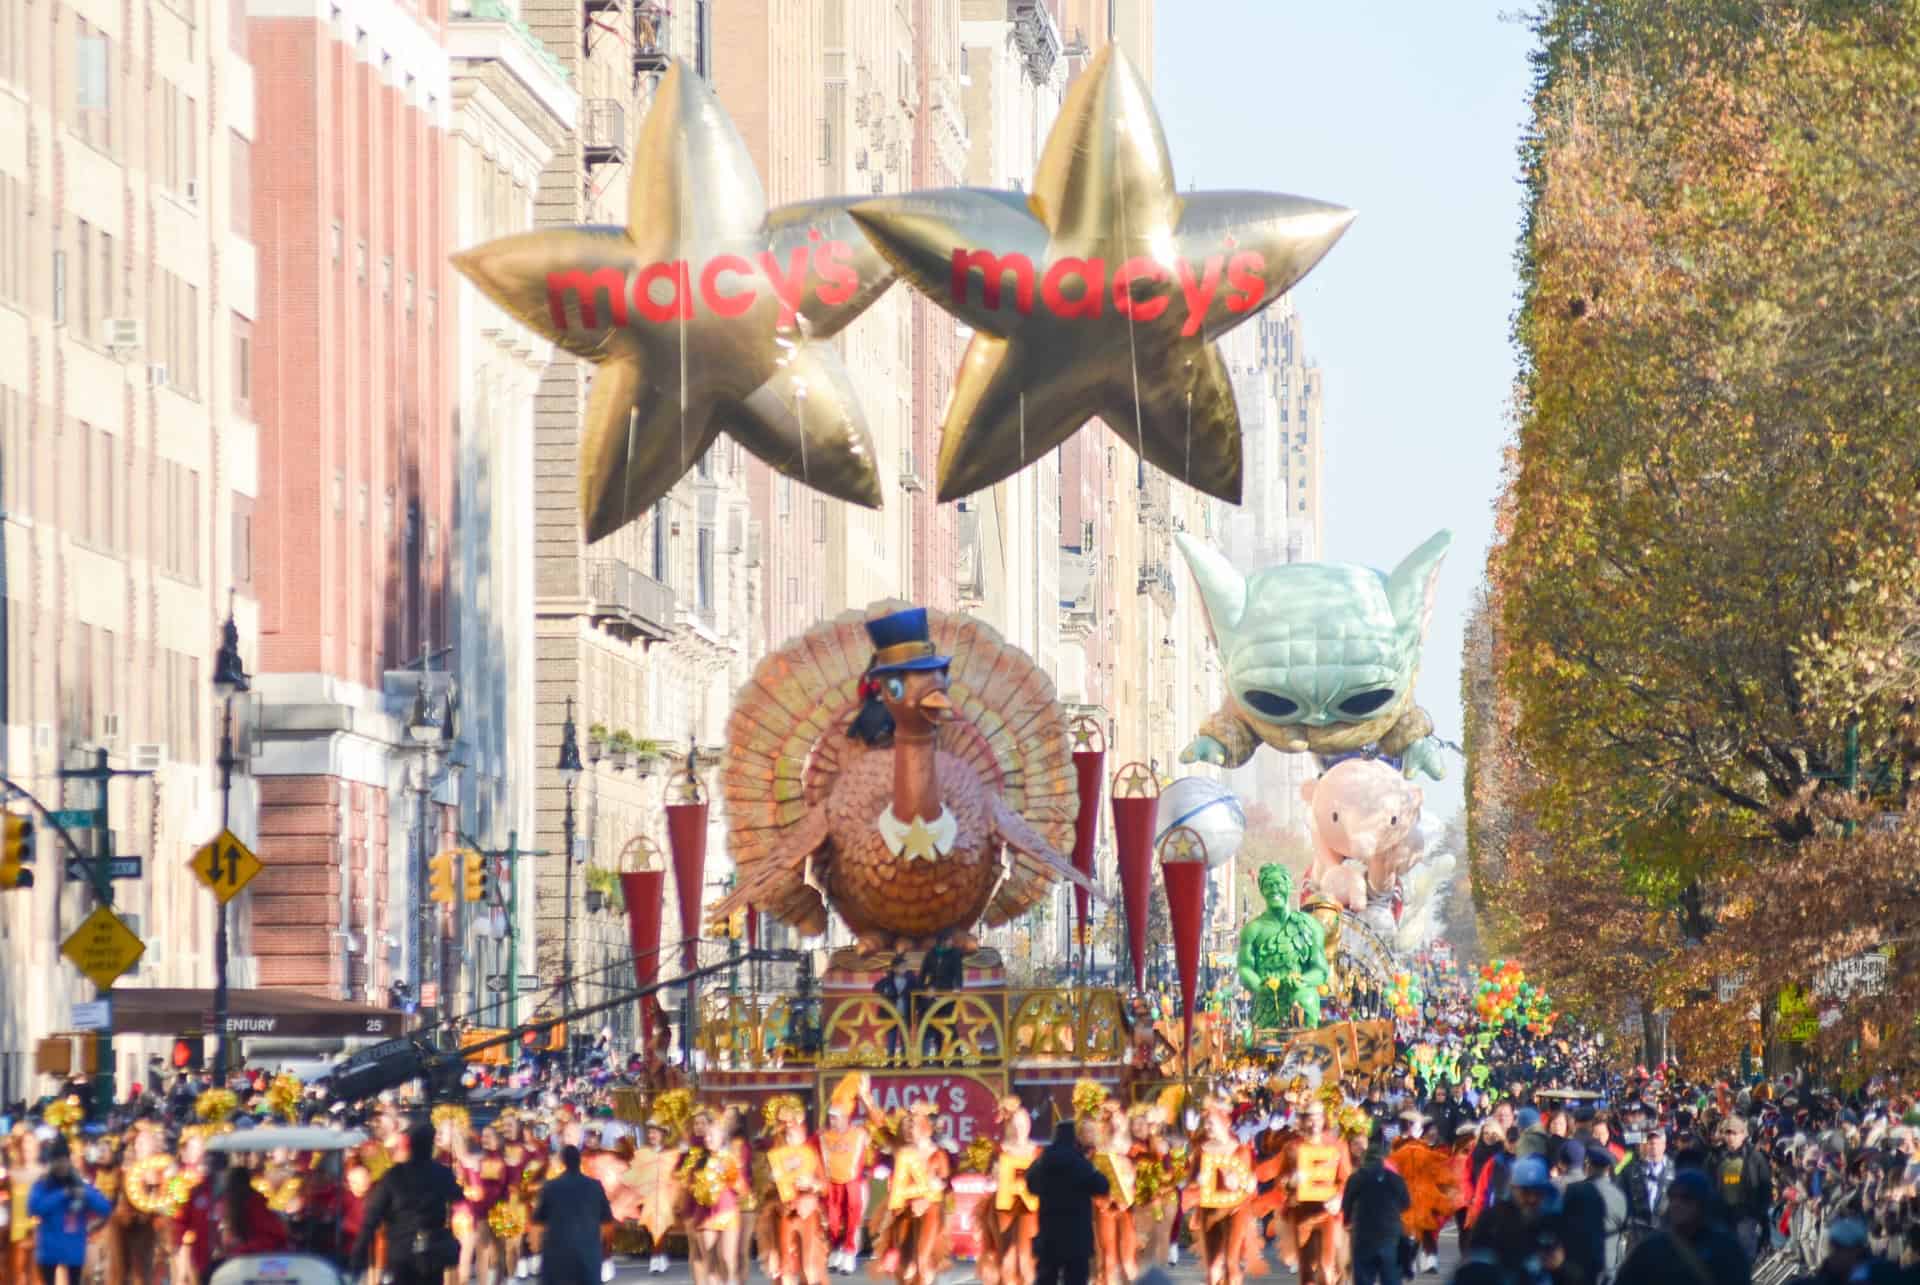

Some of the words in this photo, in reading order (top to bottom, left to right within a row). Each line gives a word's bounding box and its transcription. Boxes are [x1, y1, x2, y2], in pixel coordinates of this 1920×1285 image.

[546, 229, 859, 331] macy's
[951, 232, 1267, 336] macy's
[225, 1018, 276, 1032] ENTURY
[366, 1019, 383, 1032] 25
